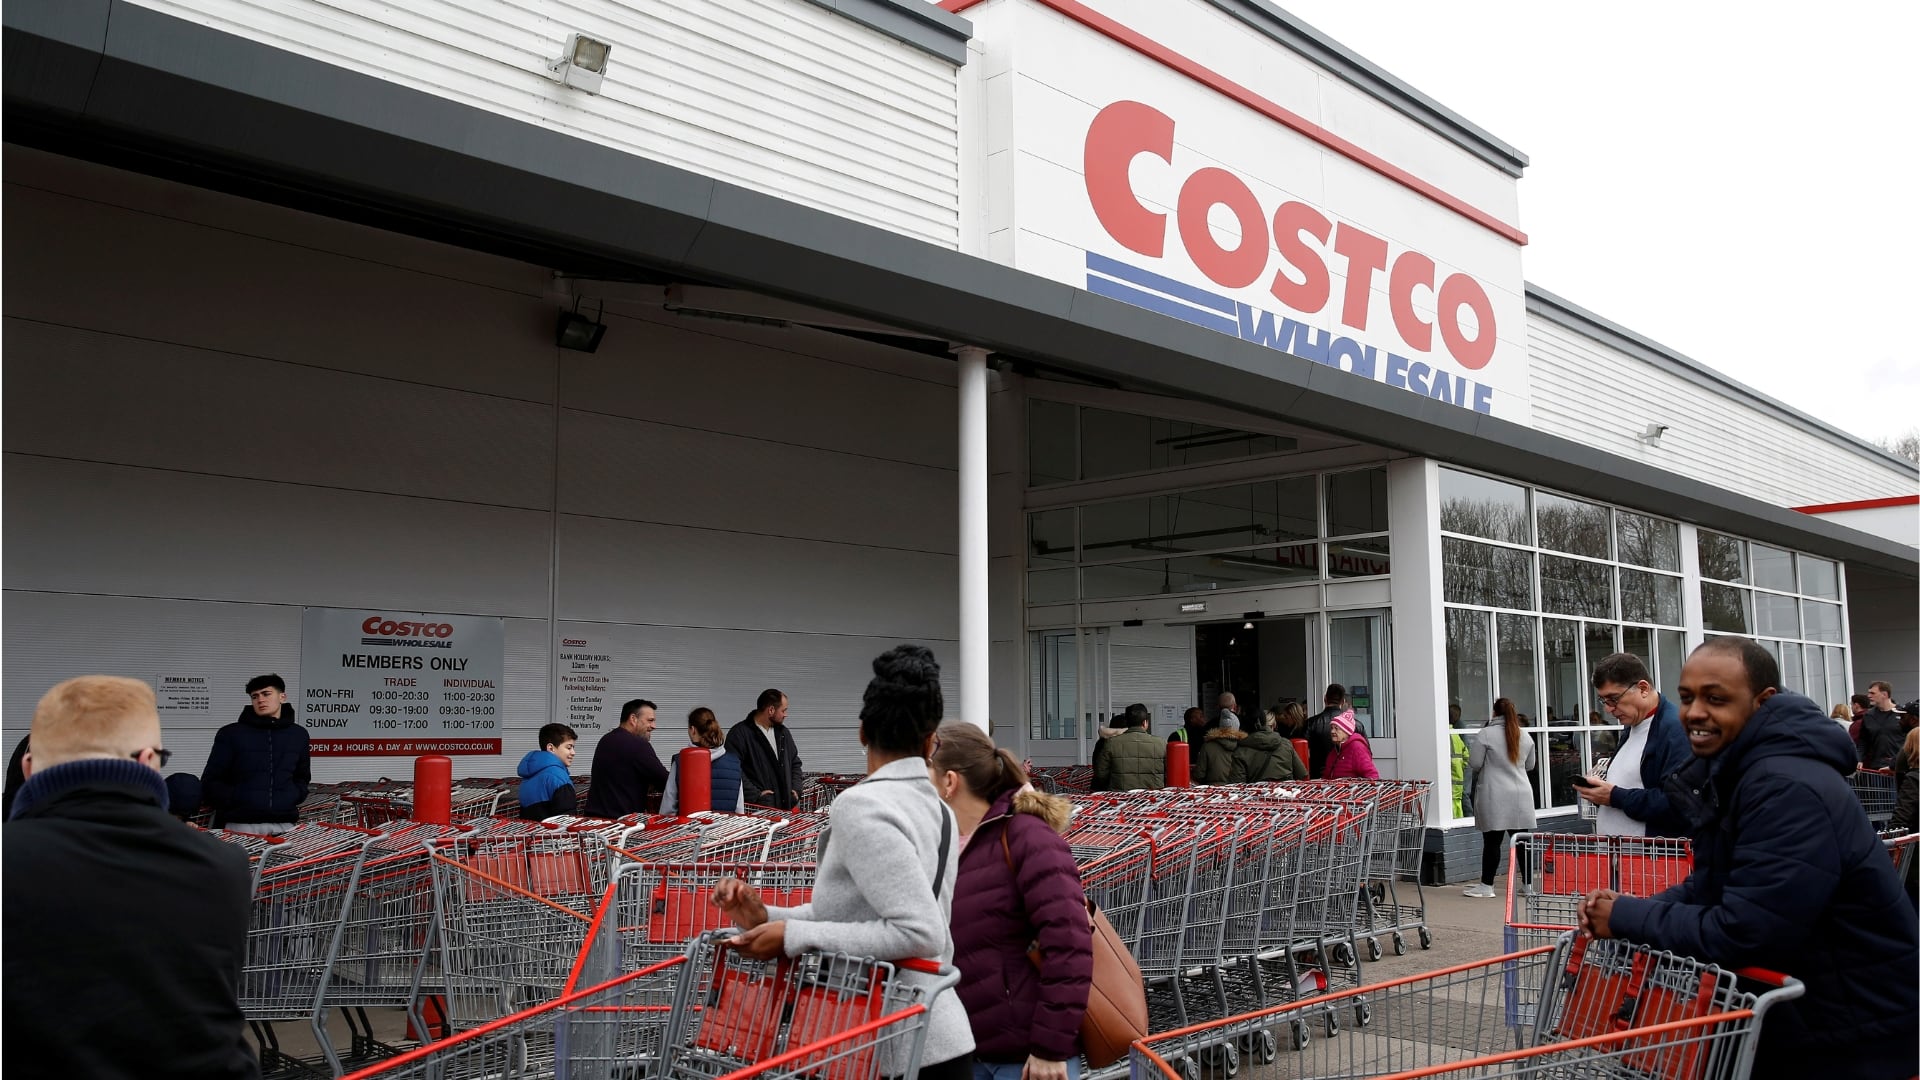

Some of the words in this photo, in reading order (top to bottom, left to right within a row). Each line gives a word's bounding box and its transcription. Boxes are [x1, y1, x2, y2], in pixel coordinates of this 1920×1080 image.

[1084, 100, 1497, 371] COSTCO
[362, 616, 454, 638] COSTCO
[393, 639, 452, 648] WHOLESALE
[342, 654, 424, 670] MEMBERS
[430, 657, 468, 671] ONLY
[384, 677, 417, 687] TRADE
[443, 679, 496, 688] INDIVIDUAL
[306, 689, 354, 698] MON-FRI
[372, 691, 429, 701] 10:00-20:30
[443, 692, 496, 702] 11:00-20:30
[306, 704, 360, 713] SATURDAY
[369, 706, 429, 715] 09:30-19:00
[439, 706, 495, 715] 09:30-19:00
[305, 719, 348, 728] SUNDAY
[373, 720, 429, 729] 11:00-17:00
[442, 720, 495, 729] 11:00-17:00
[309, 744, 330, 752] OPEN
[333, 744, 343, 752] 24
[347, 744, 375, 752] HOURS
[415, 743, 494, 751] WWW.COSTCO.CO.UK
